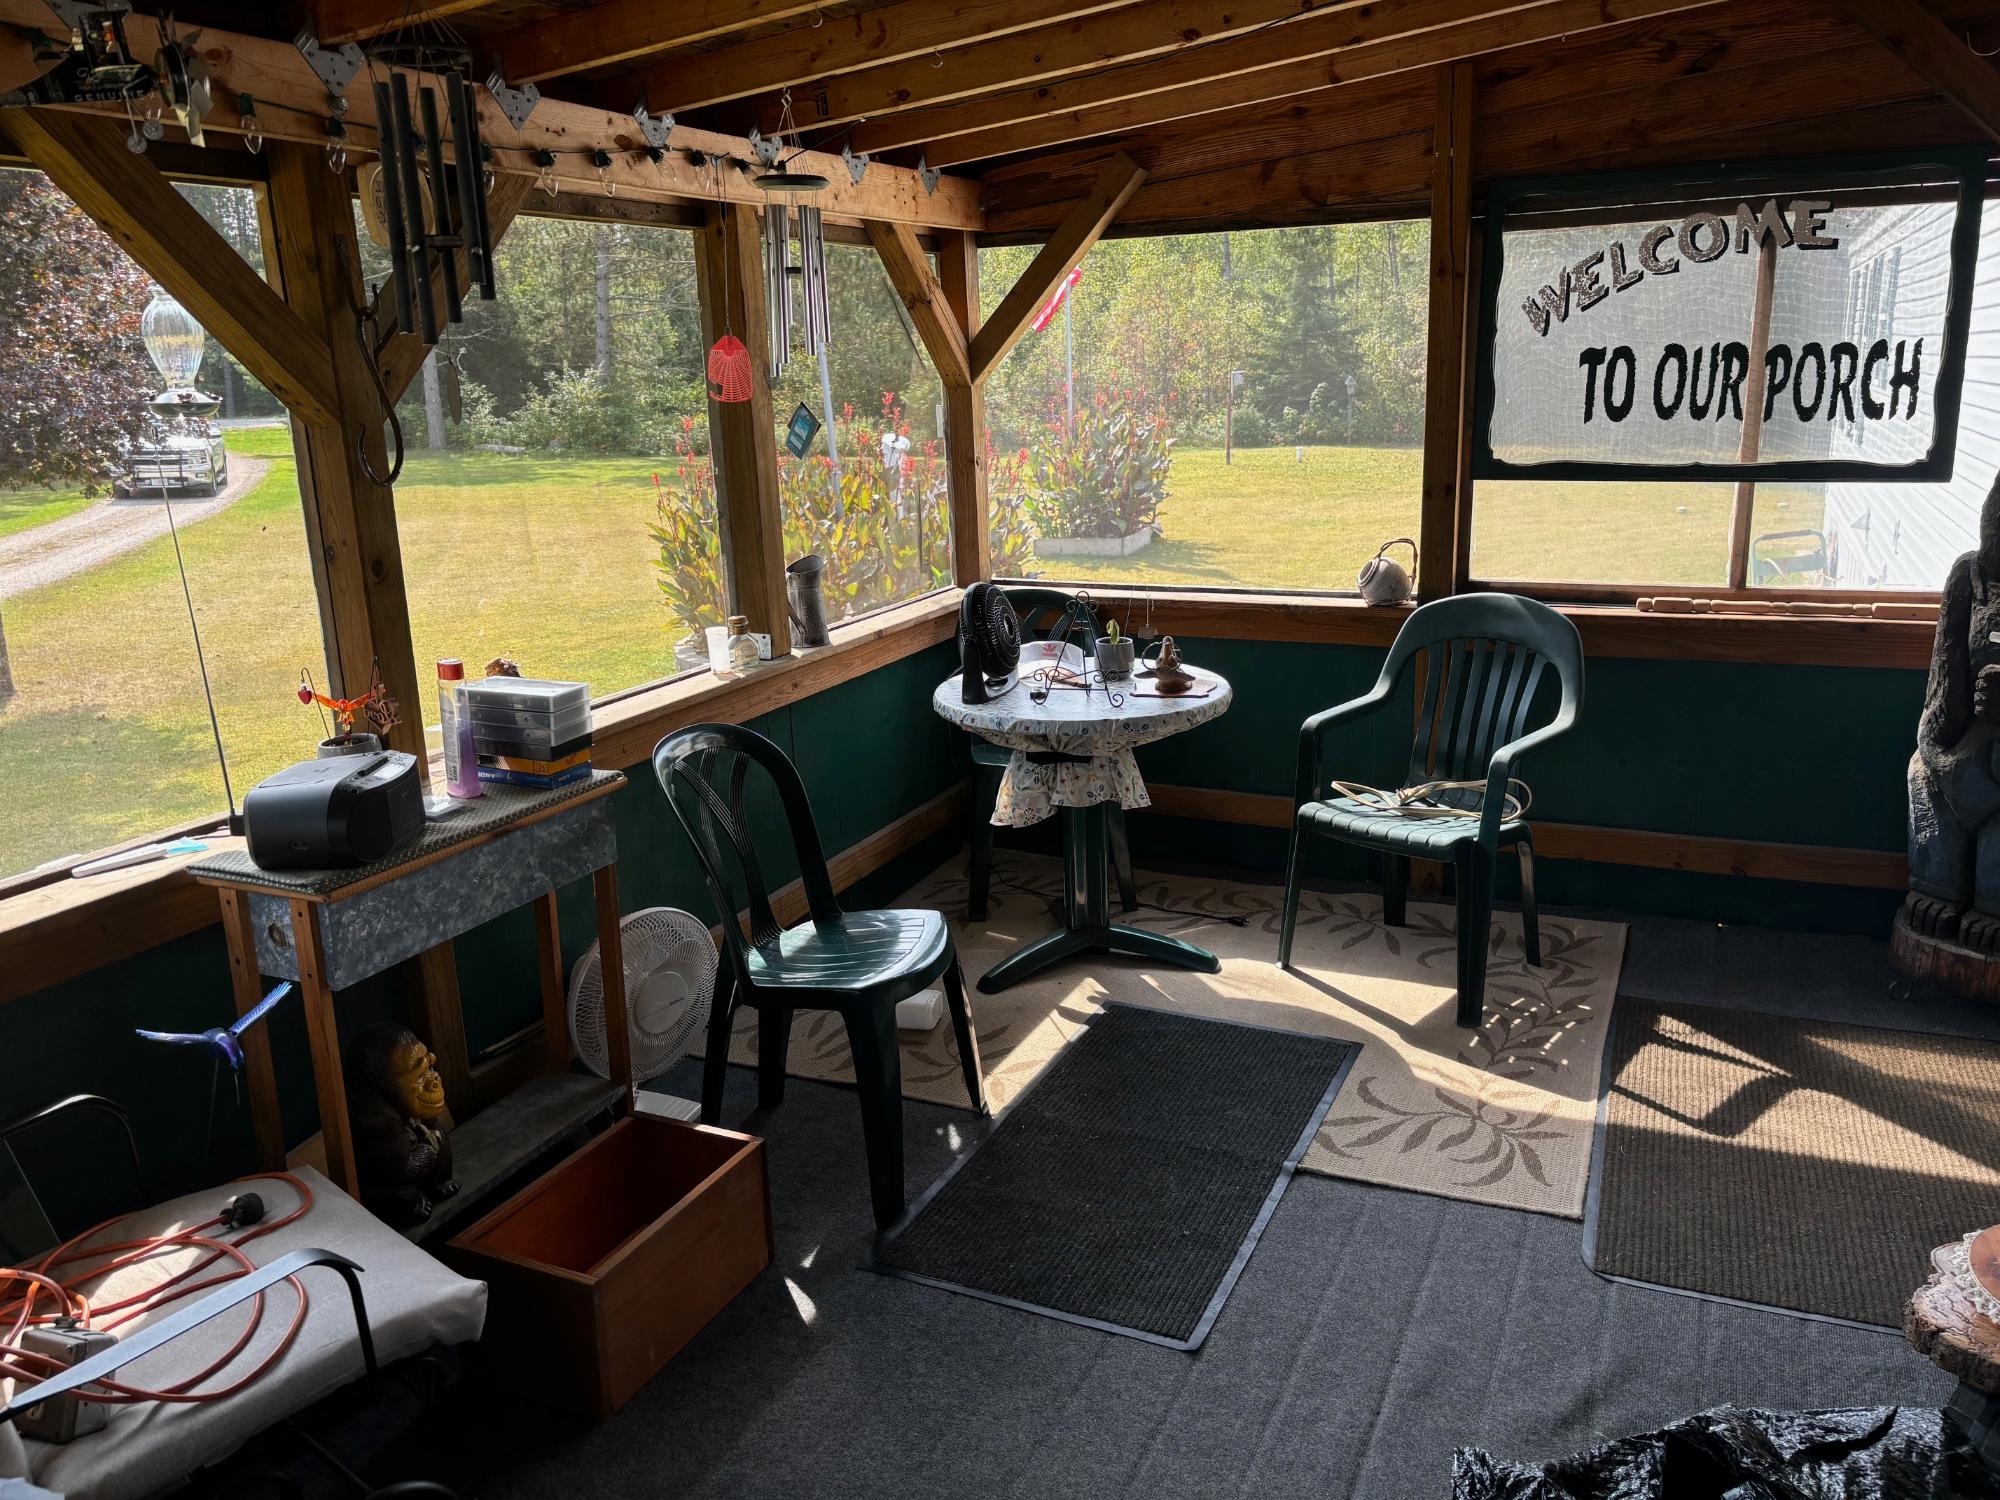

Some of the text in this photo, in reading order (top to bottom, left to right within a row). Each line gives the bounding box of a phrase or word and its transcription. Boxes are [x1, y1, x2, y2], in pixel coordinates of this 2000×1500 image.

[1521, 198, 1839, 337] WELCOME
[1579, 337, 1924, 424] TO OUR PORCH
